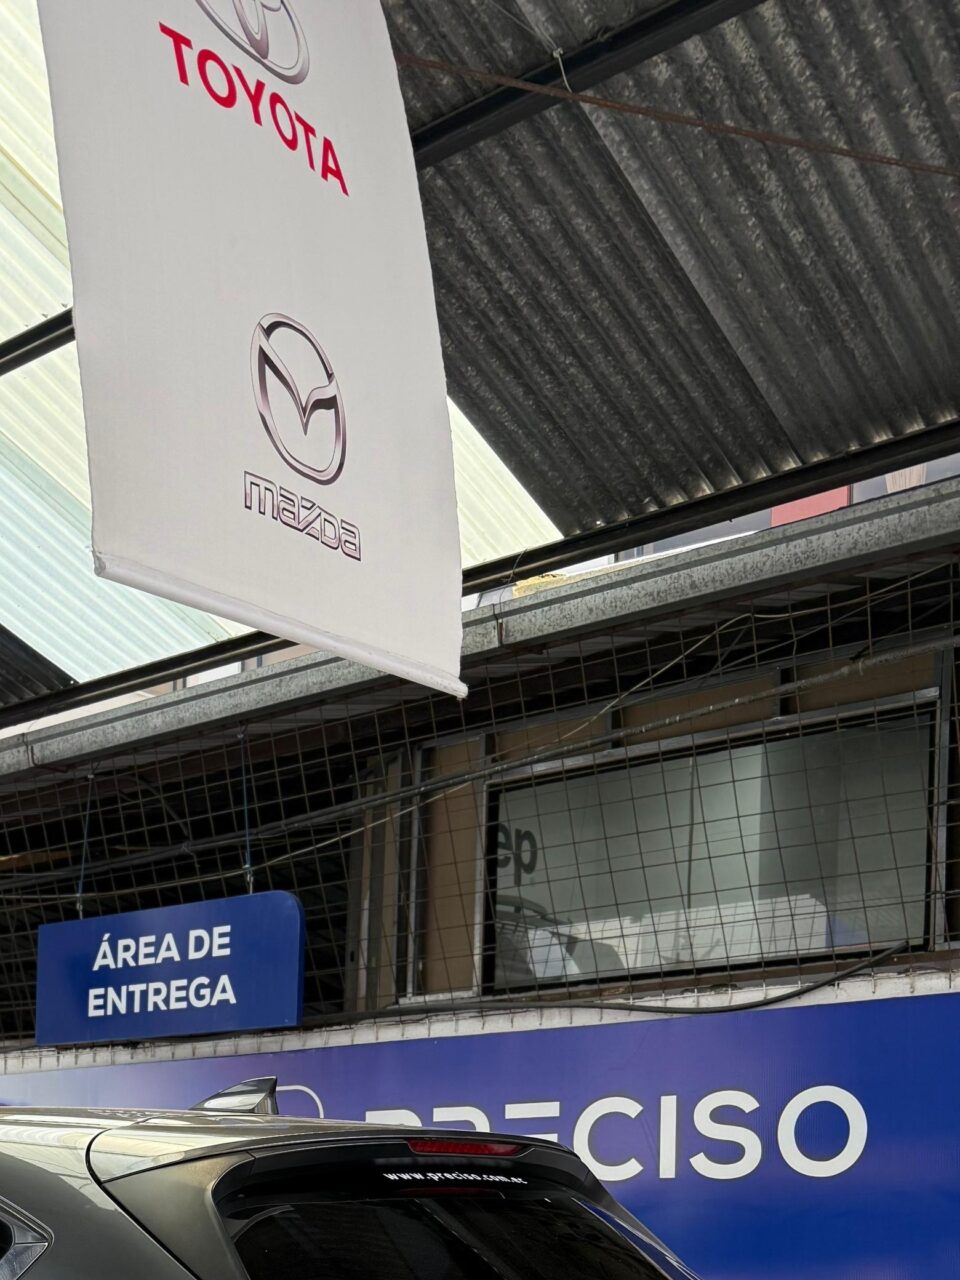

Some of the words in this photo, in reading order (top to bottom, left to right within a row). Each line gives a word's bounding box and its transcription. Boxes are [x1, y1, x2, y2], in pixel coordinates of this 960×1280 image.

[158, 21, 349, 197] TOYOTA
[92, 933, 181, 971] ÁREA
[188, 925, 232, 960] DE
[88, 974, 237, 1017] ENTREGA
[365, 1085, 868, 1181] ECISO
[382, 1171, 529, 1185] www.preciso.com.ec
